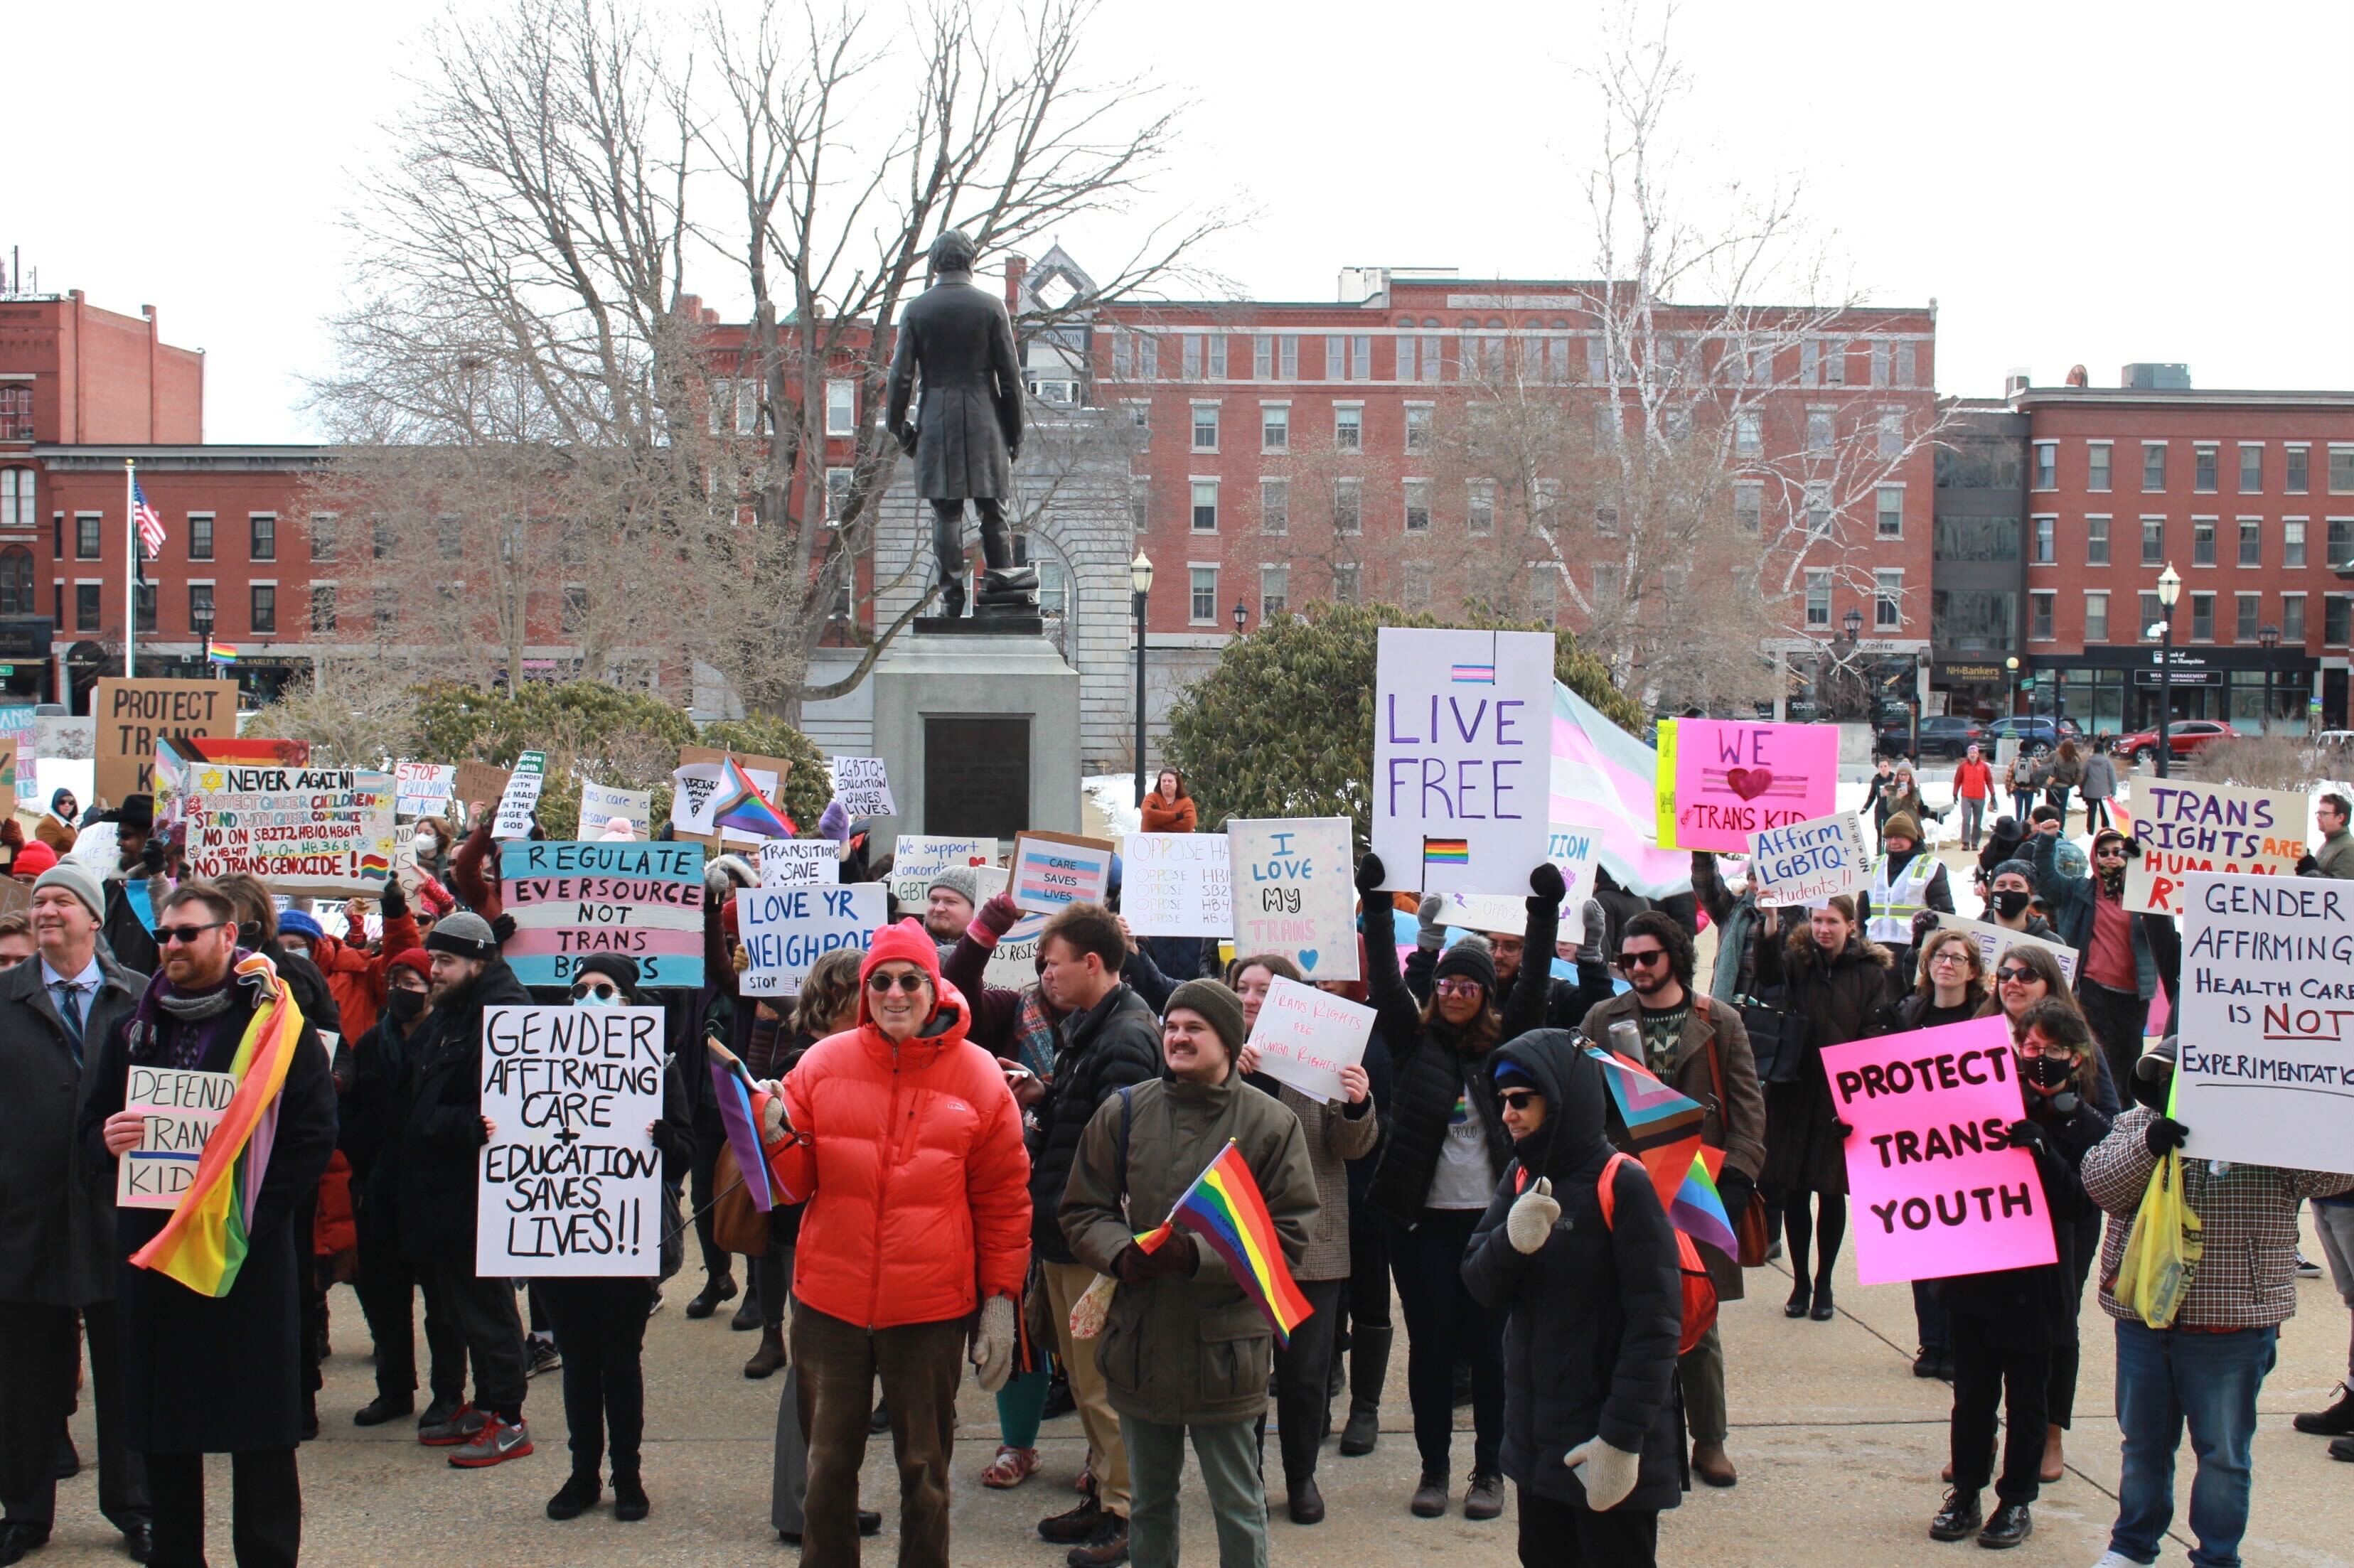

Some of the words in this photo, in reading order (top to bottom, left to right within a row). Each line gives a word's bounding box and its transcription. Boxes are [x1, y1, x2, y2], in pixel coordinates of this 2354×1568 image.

[113, 688, 219, 721] PROTECT
[1389, 694, 1524, 745] LIVE
[1718, 729, 1773, 766] WE
[228, 769, 290, 793] NEVER
[296, 770, 354, 794] AGAIN!
[397, 763, 440, 781] STOP
[838, 777, 886, 790] EDUCATION
[404, 780, 451, 797] BULLYING
[846, 791, 882, 803] SAVES
[1389, 758, 1522, 819] FREE
[200, 794, 261, 810] PROTECT
[311, 793, 376, 810] CHILDREN
[606, 794, 631, 807] care
[639, 800, 648, 809] is
[845, 803, 890, 815] LIVES
[2149, 788, 2274, 829] TRANS
[195, 811, 237, 829] STAND
[239, 812, 273, 828] WITH
[630, 819, 648, 829] are
[1693, 804, 1755, 831] TRANS
[203, 828, 223, 847] NO
[228, 828, 248, 844] ON
[898, 837, 914, 855] We
[924, 840, 979, 859] support
[1133, 836, 1206, 861] OPPOSE
[1268, 832, 1295, 857] I
[1758, 825, 1843, 860] Affirm
[2134, 820, 2260, 859] RIGHTS
[2262, 837, 2304, 860] ARE
[528, 845, 692, 875] REGULATE
[760, 843, 840, 861] TRANSITIONS
[1049, 858, 1077, 871] CARE
[193, 858, 220, 877] NO
[223, 856, 269, 875] TRANS
[780, 862, 819, 880] SAVE
[1135, 869, 1189, 882] OPPOSE
[1252, 858, 1312, 881] LOVE
[1858, 857, 1870, 873] NO
[515, 878, 701, 906] EVERSOURCE
[1044, 873, 1077, 886] SAVES
[1135, 884, 1184, 897] OPPOSE
[749, 892, 810, 924] LOVE
[823, 890, 859, 920] YR
[1044, 888, 1073, 901] LIVES
[1135, 898, 1183, 910] OPPOSE
[1263, 888, 1301, 913] MY
[2205, 883, 2345, 922] GENDER
[577, 902, 632, 924] NOT
[1135, 913, 1182, 925] OPPOSE
[557, 930, 647, 951] TRANS
[1247, 918, 1316, 943] TRANS
[2189, 925, 2353, 965] AFFIRMING
[749, 976, 776, 988] STOP
[2195, 967, 2291, 997] HEALTH
[1273, 982, 1307, 1013] TRANS
[1314, 999, 1361, 1030] RIGHTS
[1293, 1022, 1315, 1036] ARE
[2228, 1004, 2251, 1024] IS
[2264, 1002, 2354, 1036] NOT
[487, 1010, 661, 1066] GENDER
[1297, 1046, 1338, 1073] RIGHTS
[484, 1058, 658, 1100] AFFIRMING
[1836, 1046, 2008, 1105] PROTECT
[131, 1070, 235, 1111] DEFEND
[520, 1092, 614, 1128] CARE
[140, 1115, 218, 1151] TRAN
[1452, 1125, 1477, 1138] PROUD
[1870, 1118, 2011, 1168] TRANS
[486, 1144, 658, 1183] EDUCATION
[505, 1176, 602, 1213] SAVES
[1870, 1182, 2033, 1234] YOUTH
